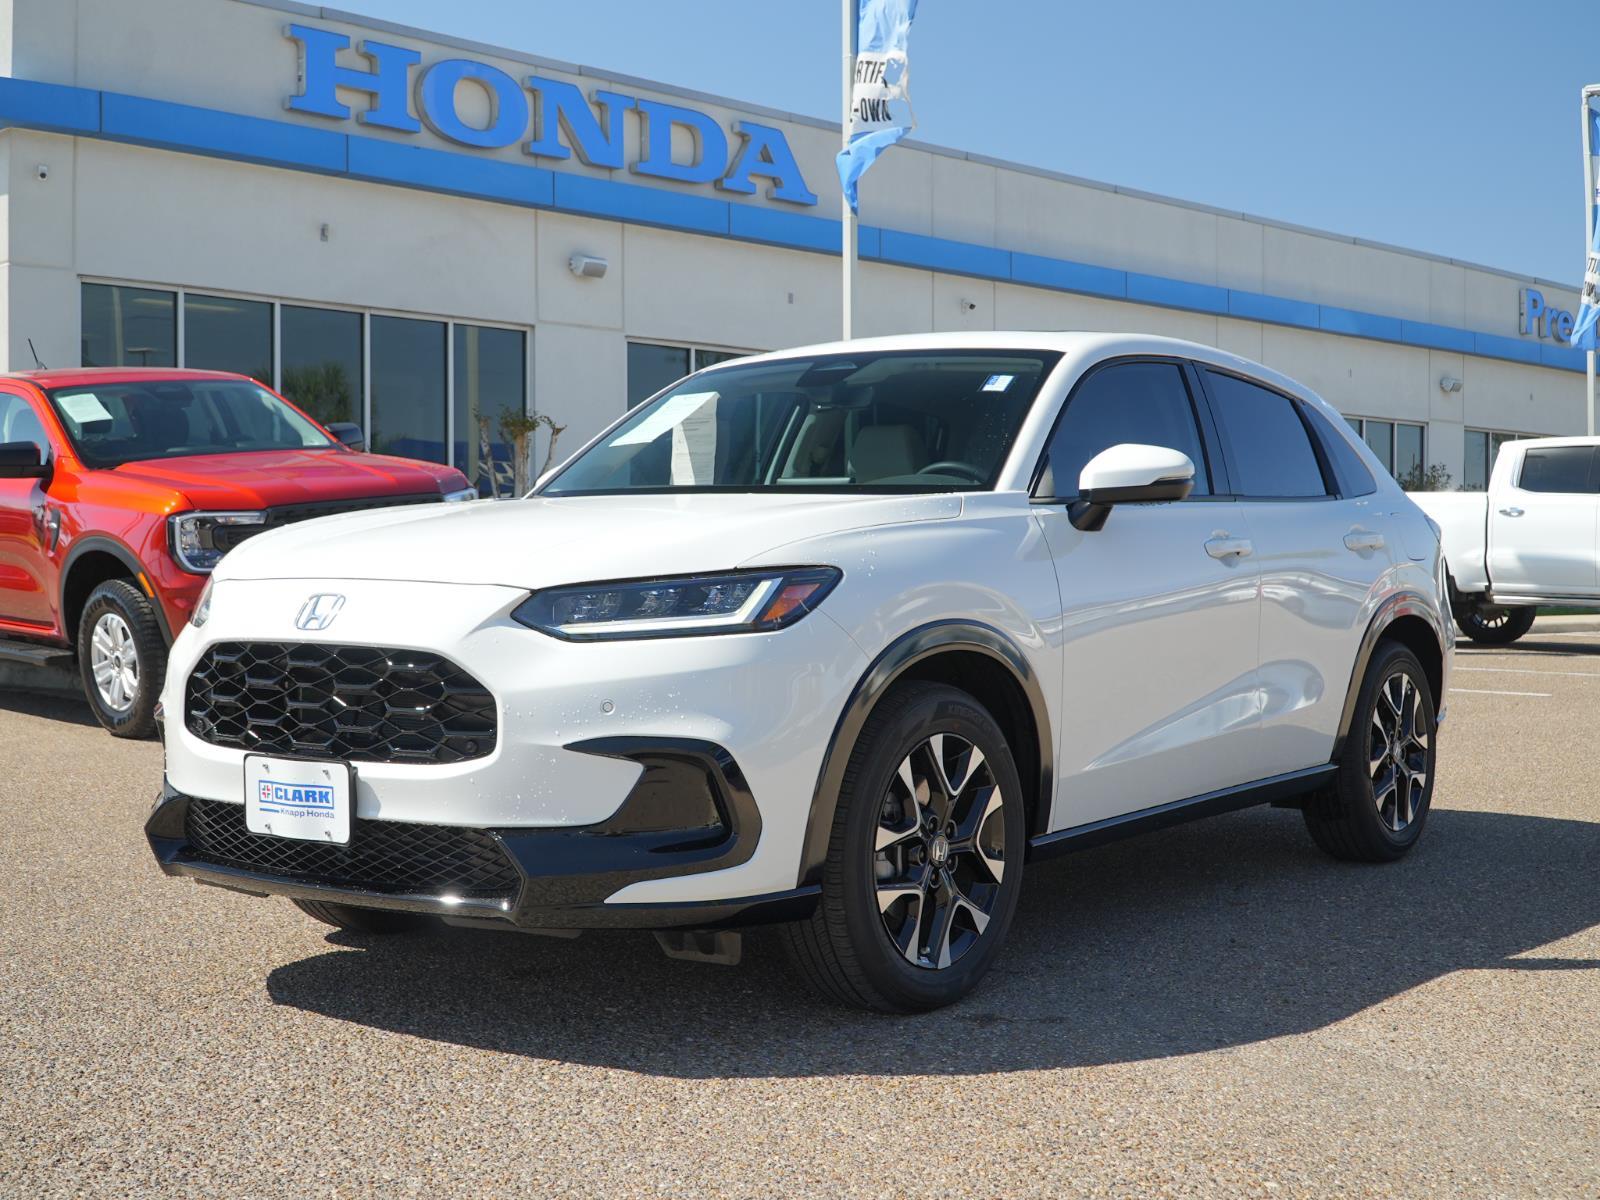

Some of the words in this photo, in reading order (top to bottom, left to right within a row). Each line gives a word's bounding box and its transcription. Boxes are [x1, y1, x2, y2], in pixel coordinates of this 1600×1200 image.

[284, 23, 817, 206] HONDA
[275, 787, 330, 803] CLARK
[281, 809, 305, 818] Knapp
[307, 810, 335, 818] Honda
